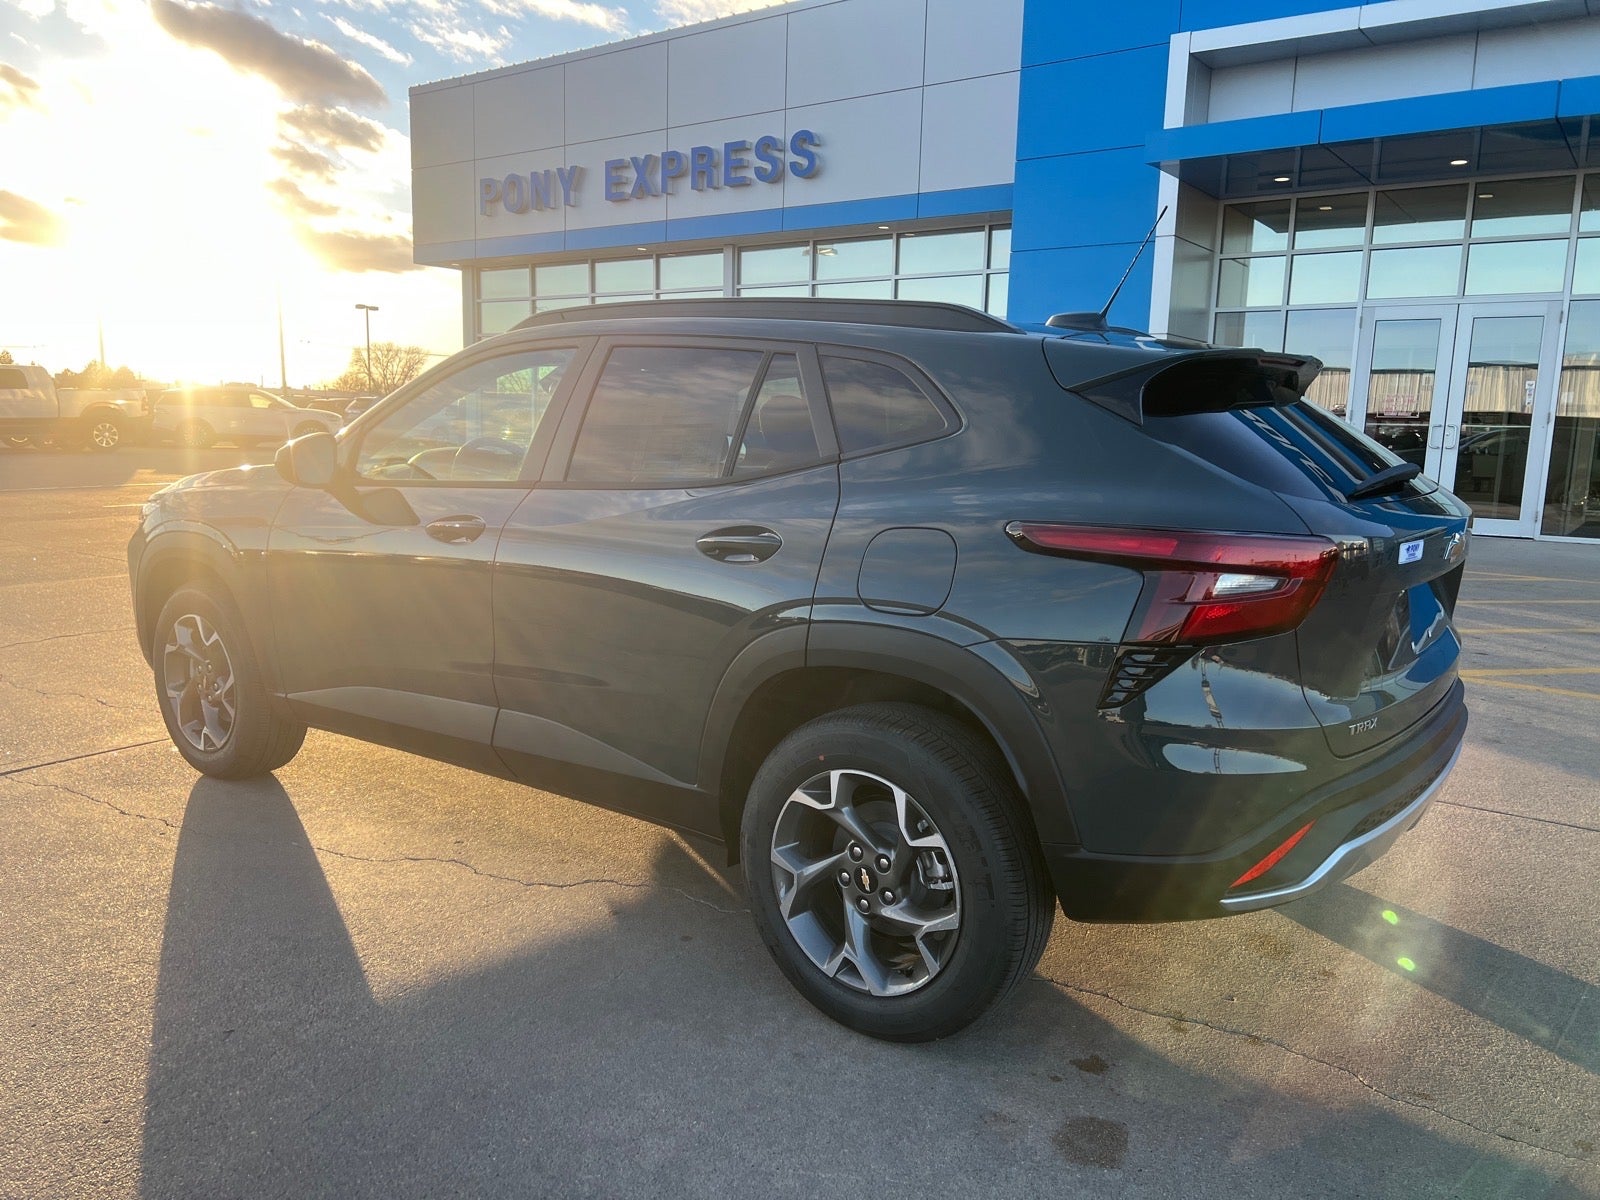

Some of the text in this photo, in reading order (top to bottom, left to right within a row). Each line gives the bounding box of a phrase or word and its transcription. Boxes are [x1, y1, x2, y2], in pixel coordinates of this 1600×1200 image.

[479, 130, 821, 216] PONY EXPRESS
[1348, 717, 1378, 736] TRAX
